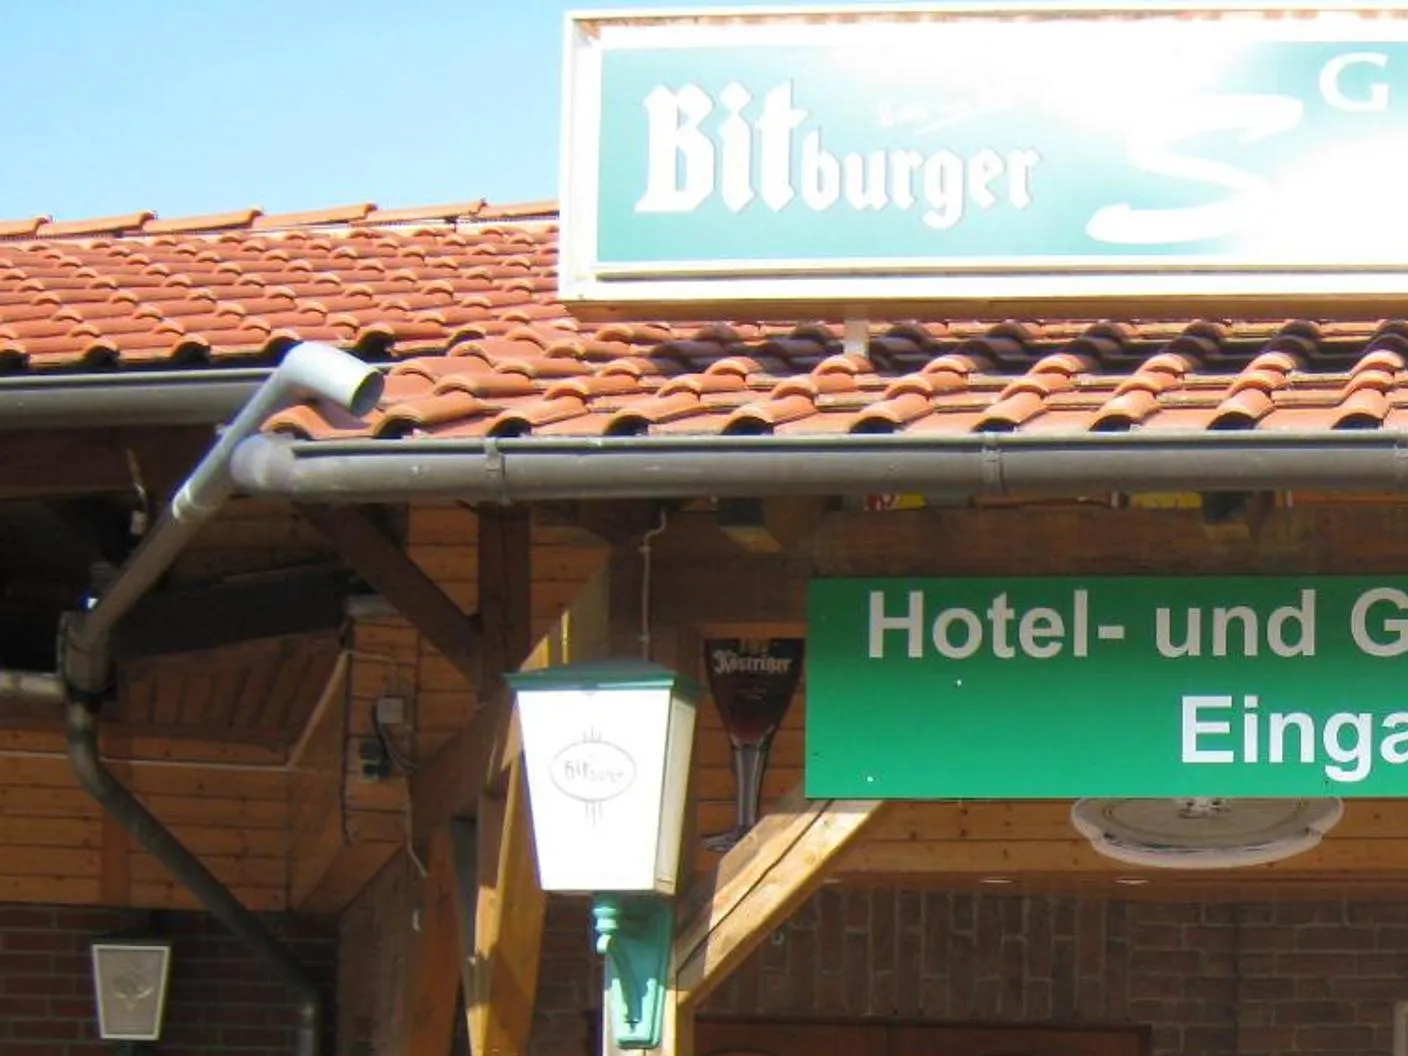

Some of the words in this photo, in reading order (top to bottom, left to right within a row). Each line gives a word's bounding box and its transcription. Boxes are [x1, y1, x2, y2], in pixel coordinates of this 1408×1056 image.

[633, 77, 1043, 231] Bitburger
[867, 589, 1126, 660] Hotel-
[1154, 588, 1317, 658] und
